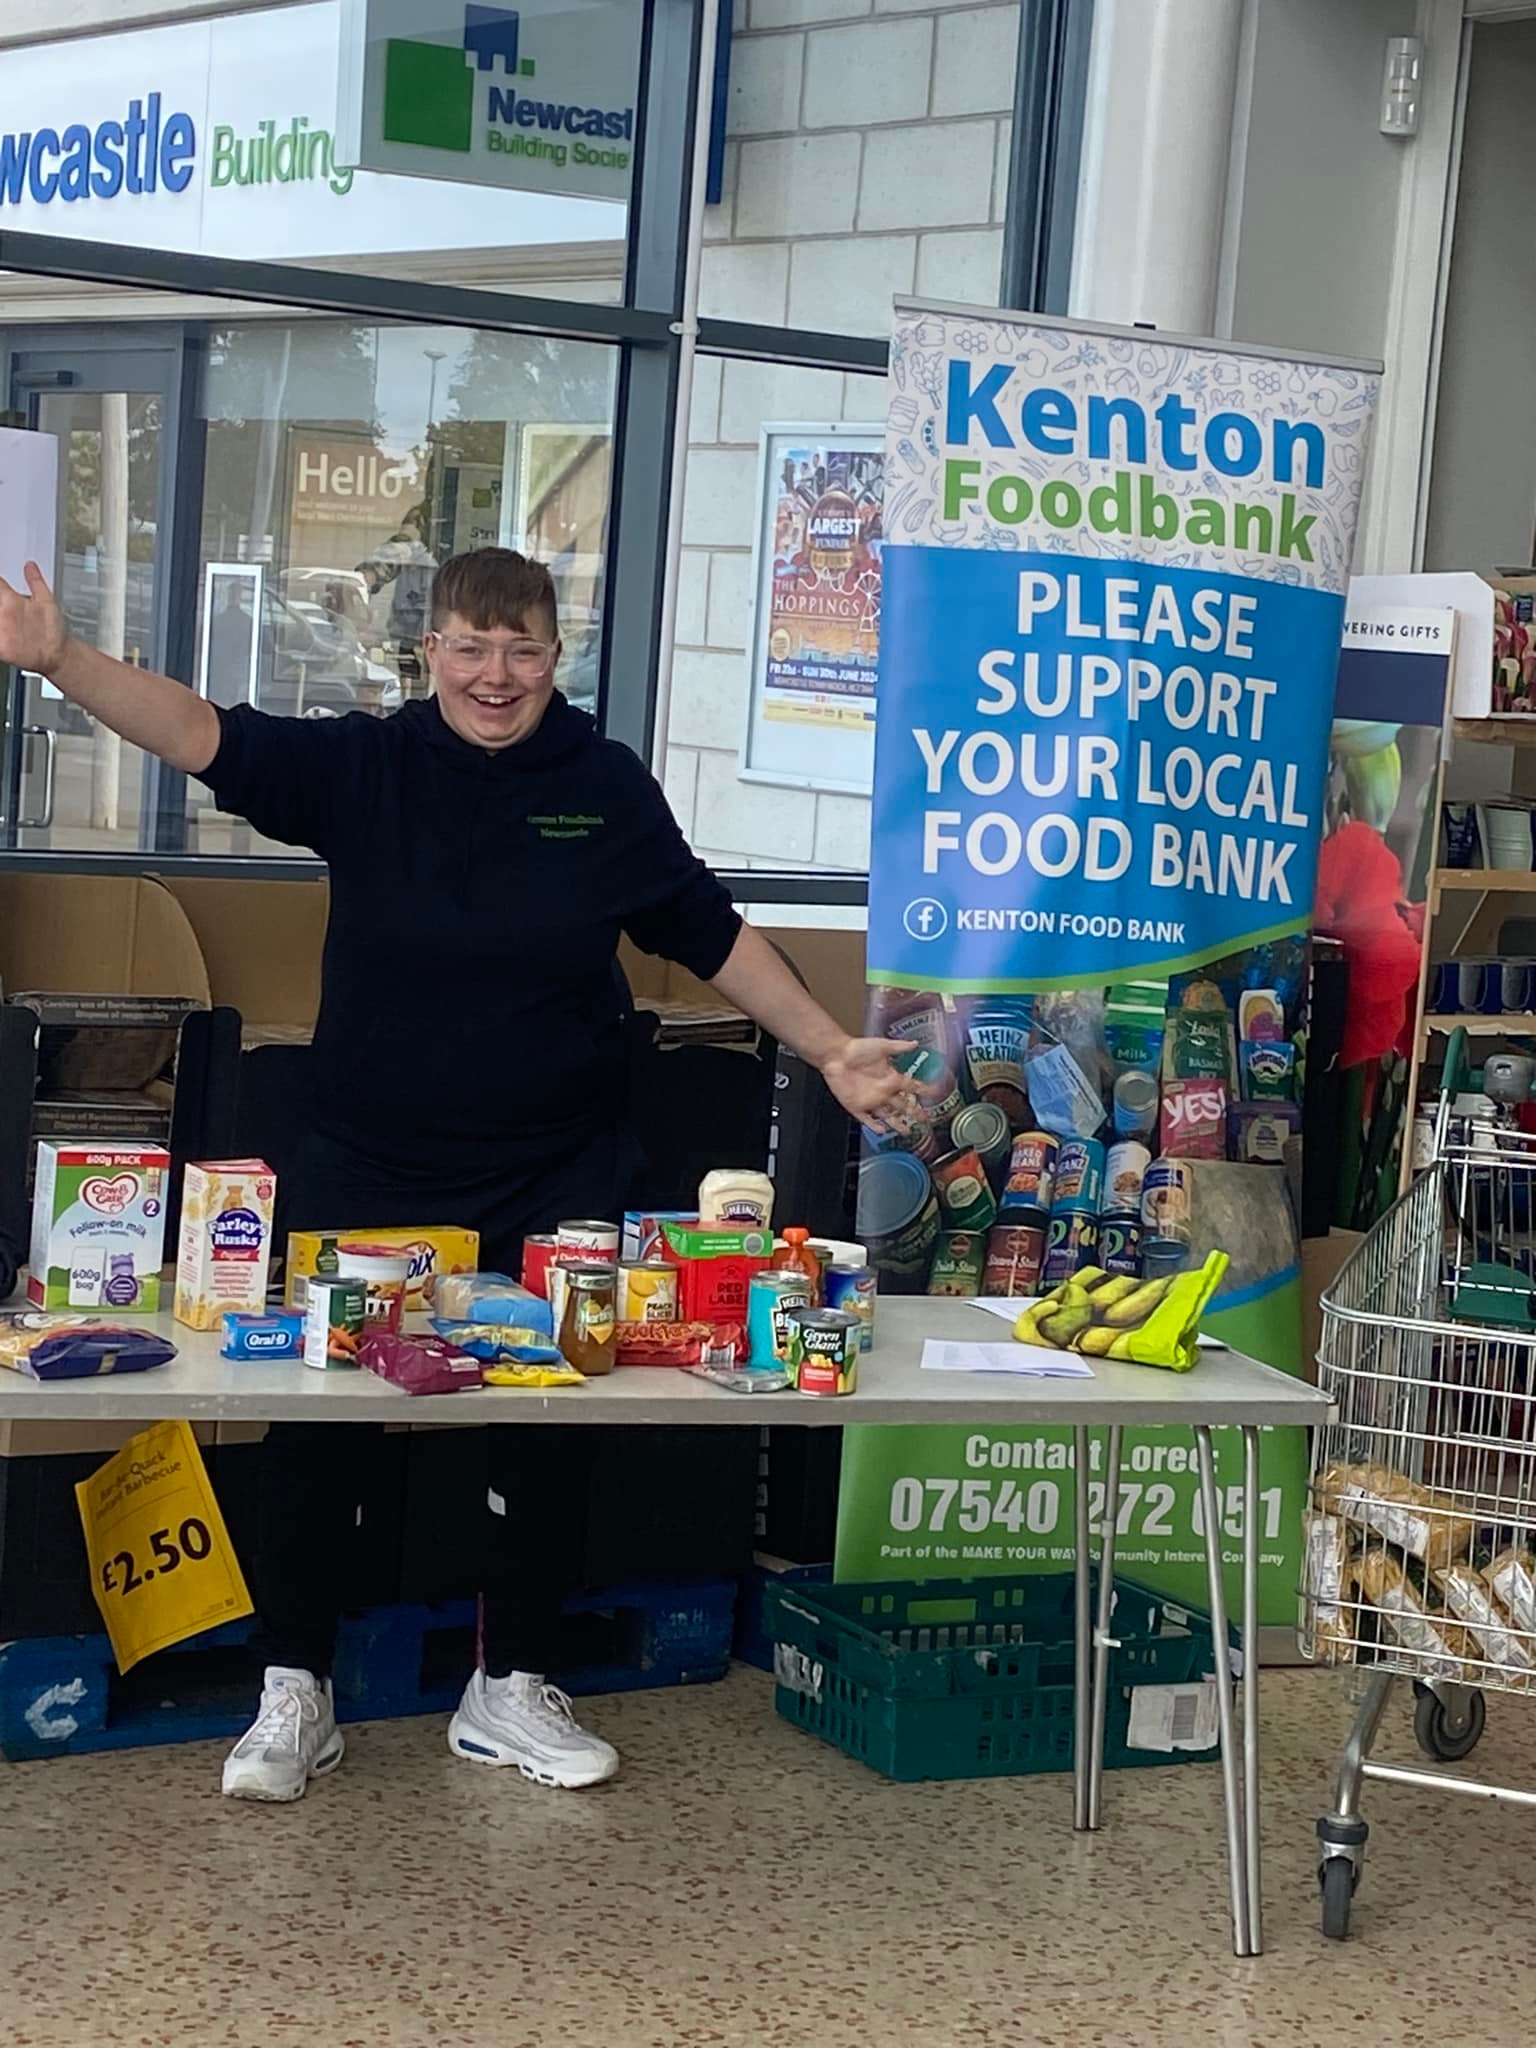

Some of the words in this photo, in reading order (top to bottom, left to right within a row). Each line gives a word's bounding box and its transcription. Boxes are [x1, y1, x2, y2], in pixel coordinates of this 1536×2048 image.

[487, 130, 567, 166] Building
[945, 360, 1325, 489] Kenton
[299, 452, 402, 499] Hello
[942, 459, 1315, 562] Foodbank
[807, 518, 861, 535] LARGEST
[774, 594, 861, 617] HOPPINGS
[1018, 571, 1258, 659] PLEASE
[1400, 625, 1441, 639] GIFTS
[976, 650, 1277, 741] SUPPORT
[911, 728, 1121, 799] YOUR
[1137, 741, 1309, 827] LOCAL
[922, 811, 1133, 882] FOOD
[1150, 824, 1298, 904] BANK
[956, 910, 1055, 934] KENTON
[1058, 913, 1122, 938] FOOD
[1126, 917, 1186, 943] BANK
[977, 1029, 1024, 1047] HEINZ
[1116, 1048, 1148, 1061] Milk
[1162, 1086, 1227, 1129] YES!
[86, 1155, 113, 1167] 600g
[114, 1155, 142, 1165] PACK
[145, 1200, 157, 1216] 2
[728, 1202, 758, 1217] HEINZ
[69, 1218, 125, 1239] Follow-on
[208, 1217, 268, 1237] Farley's
[214, 1233, 258, 1246] Rusks
[72, 1270, 101, 1283] 600g
[716, 1282, 744, 1293] RED
[708, 1293, 745, 1306] LABE
[248, 1332, 287, 1347] Oral-B
[803, 1328, 840, 1343] Green
[804, 1338, 843, 1351] Giant
[890, 1477, 1060, 1535] 07540
[1087, 1480, 1176, 1537] 272
[102, 1517, 212, 1596] £2.50
[880, 1544, 911, 1558] Part
[915, 1545, 931, 1558] of
[934, 1545, 958, 1559] the
[961, 1546, 1003, 1560] MAKE
[1006, 1547, 1047, 1560] YOUR
[1089, 1549, 1160, 1564] omunity
[1164, 1549, 1205, 1563] Intere
[1221, 1550, 1285, 1567] Coany
